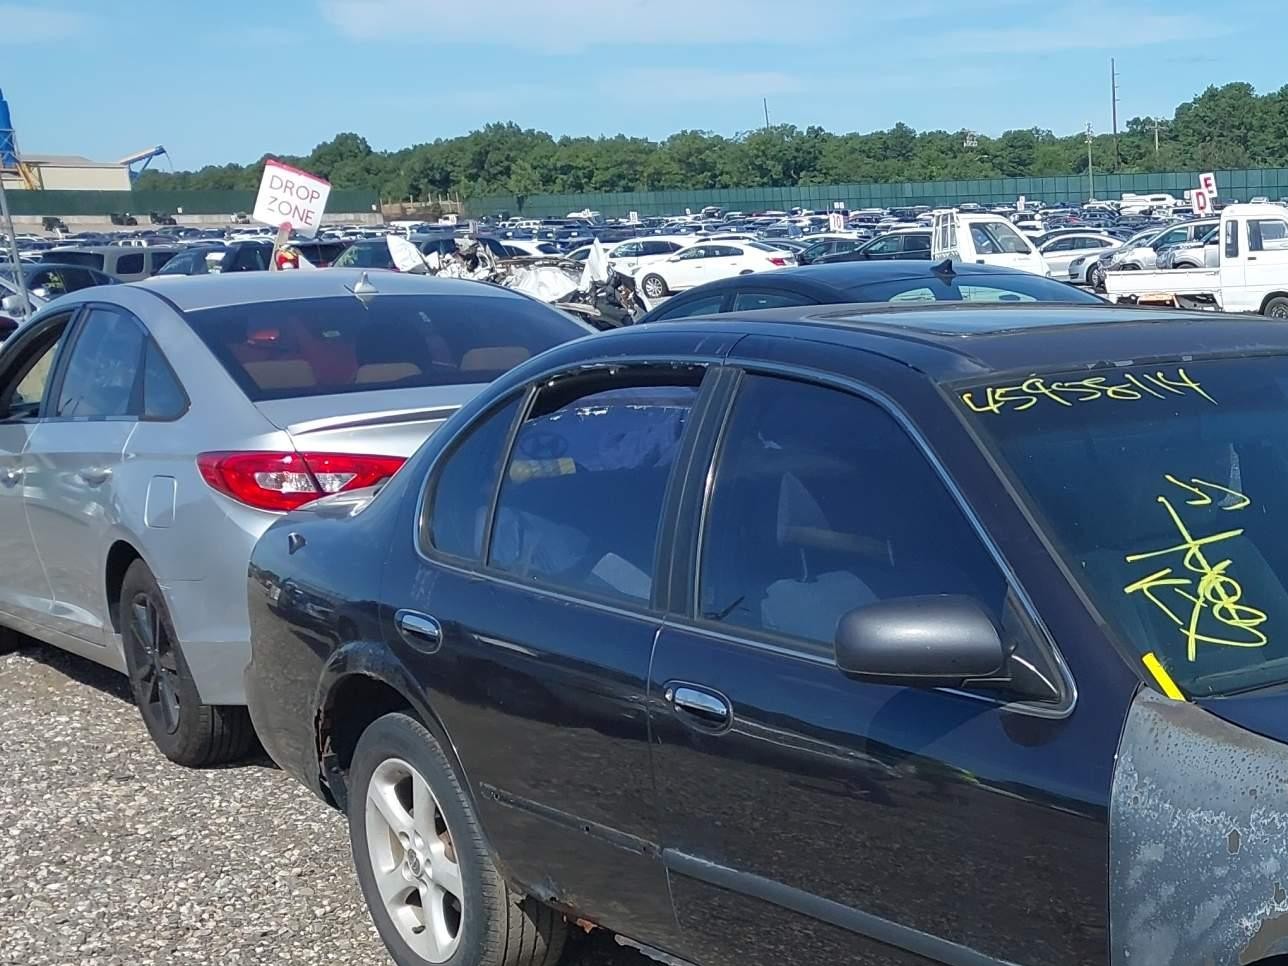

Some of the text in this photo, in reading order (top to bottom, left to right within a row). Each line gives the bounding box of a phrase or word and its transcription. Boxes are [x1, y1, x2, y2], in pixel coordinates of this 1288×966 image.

[270, 175, 320, 204] DROP
[1203, 176, 1215, 195] E
[267, 196, 315, 226] ZONE
[1195, 191, 1207, 211] D
[962, 368, 1218, 414] 45958114
